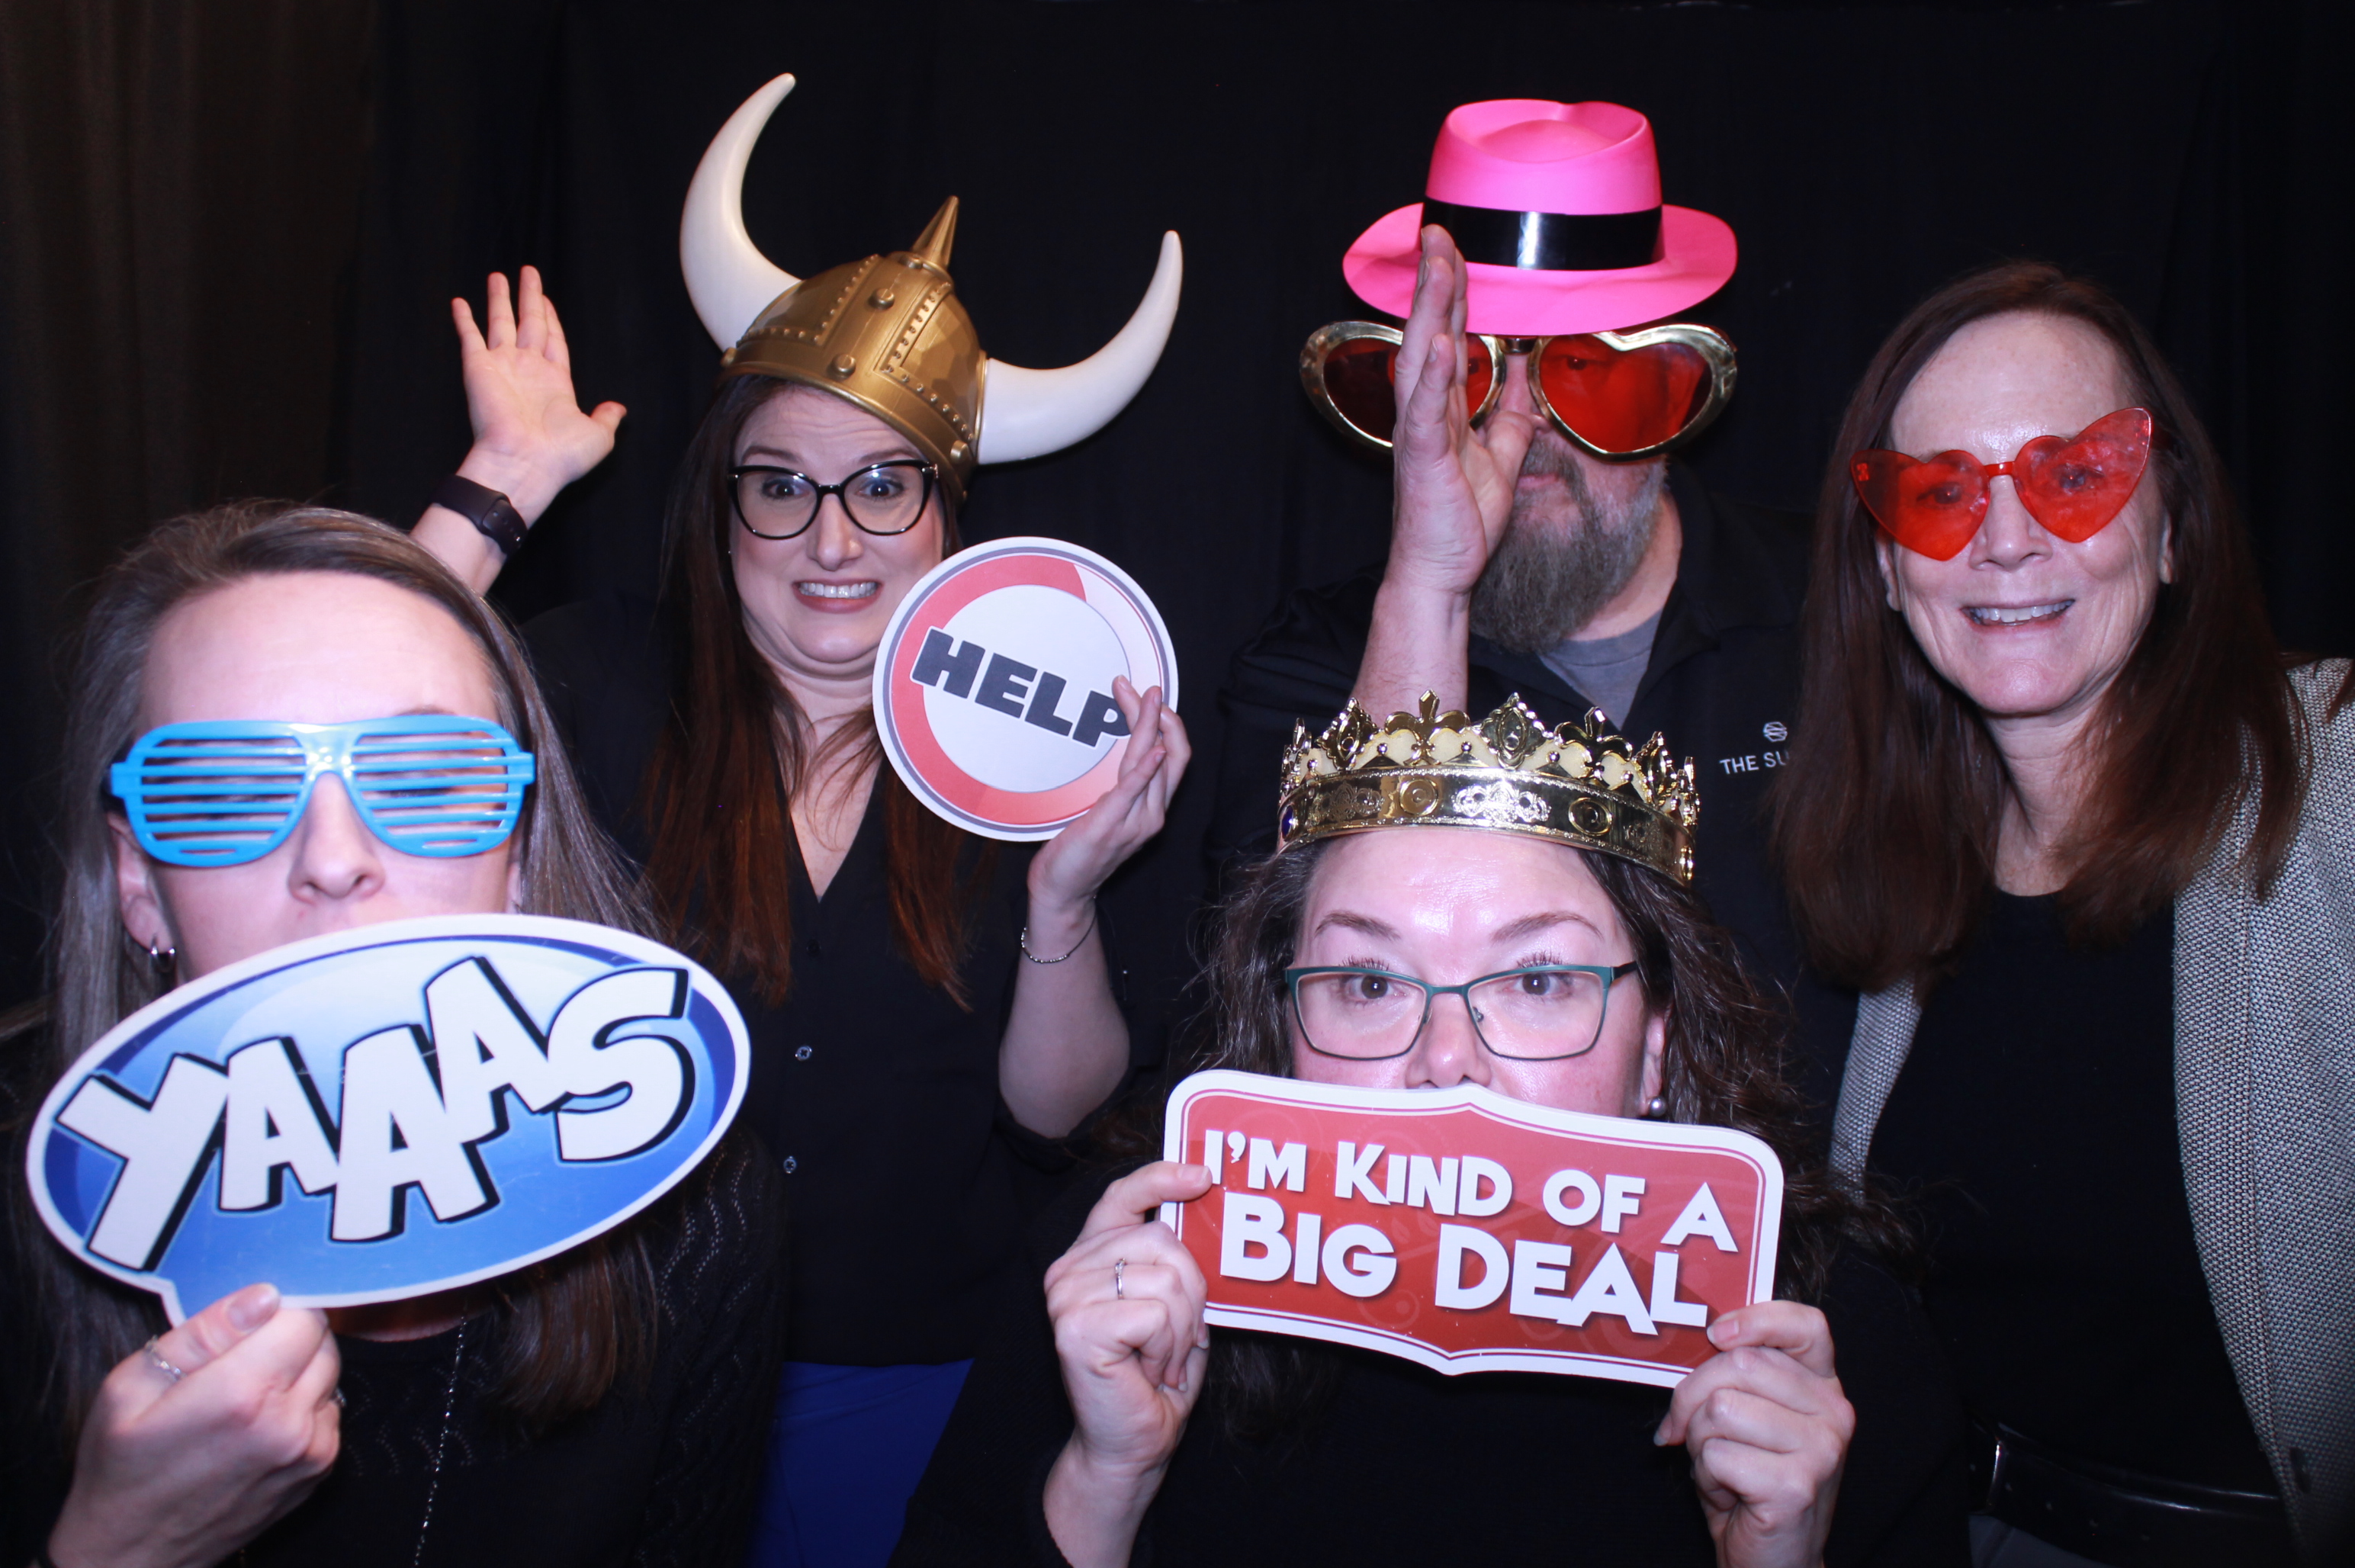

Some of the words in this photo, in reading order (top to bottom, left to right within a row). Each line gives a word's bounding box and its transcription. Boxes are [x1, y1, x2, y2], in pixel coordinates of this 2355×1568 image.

[911, 628, 1131, 747] HELP
[1719, 755, 1759, 774] THE
[56, 956, 689, 1272] YAAAS
[1203, 1129, 1307, 1193] I'M
[1334, 1140, 1513, 1217] KIND
[1542, 1168, 1646, 1234] OF
[1660, 1181, 1740, 1253] A
[1219, 1191, 1398, 1298] BIG
[1434, 1223, 1708, 1336] DEAL
